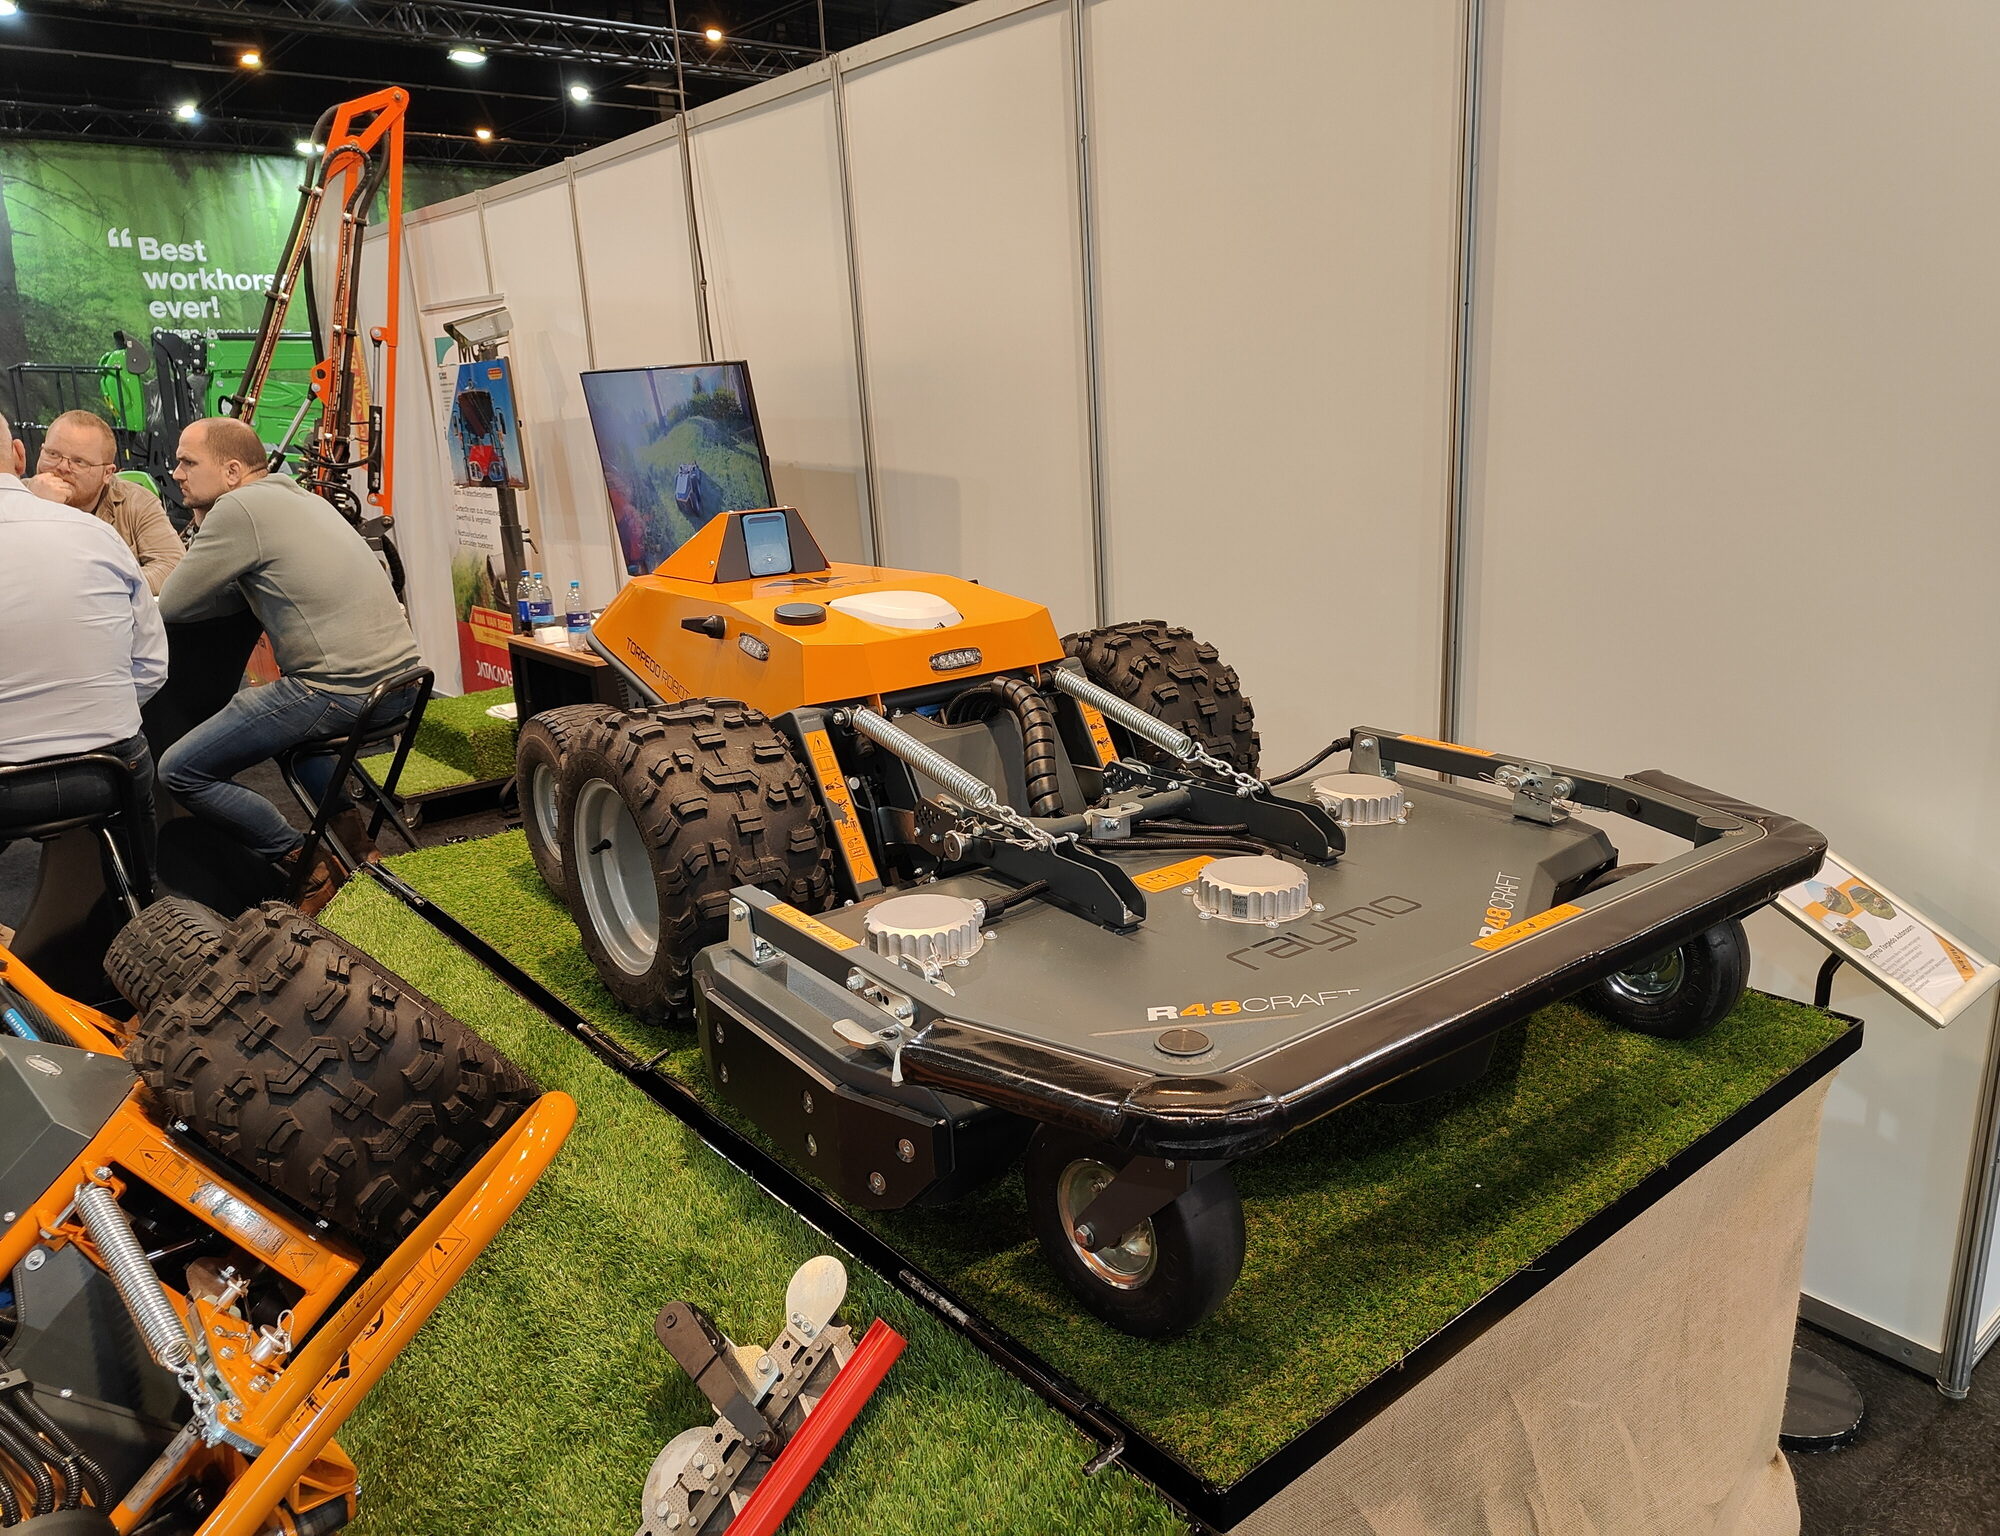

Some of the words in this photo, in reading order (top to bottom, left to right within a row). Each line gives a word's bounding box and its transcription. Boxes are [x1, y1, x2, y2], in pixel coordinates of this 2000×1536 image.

[149, 295, 221, 319] ever!
[626, 636, 661, 678] TORPEDO
[661, 669, 691, 699] ROBOT
[1225, 893, 1422, 971] raymo
[1146, 987, 1360, 1022] R48CRAFT
